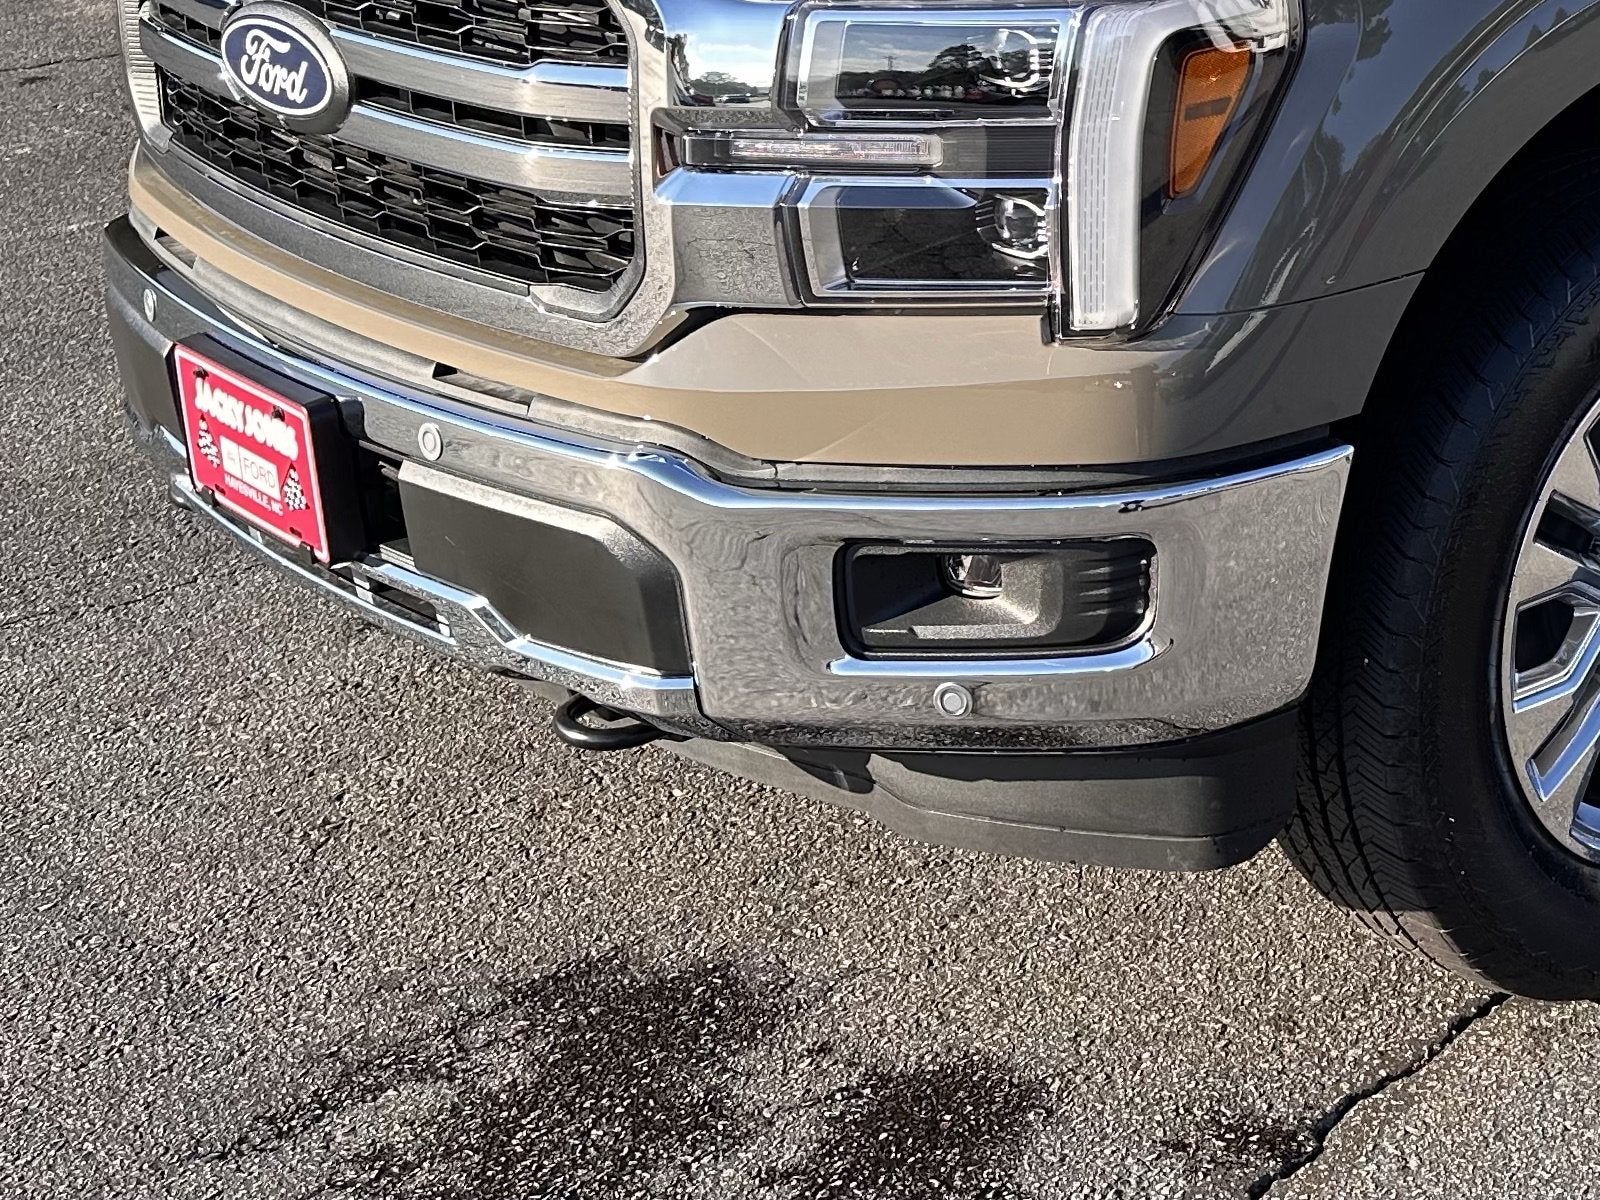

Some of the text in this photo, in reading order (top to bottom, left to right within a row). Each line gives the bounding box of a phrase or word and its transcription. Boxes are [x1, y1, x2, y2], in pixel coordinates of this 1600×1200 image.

[240, 28, 308, 103] Ford
[195, 377, 299, 462] JACKY JONES
[243, 457, 276, 489] FORD
